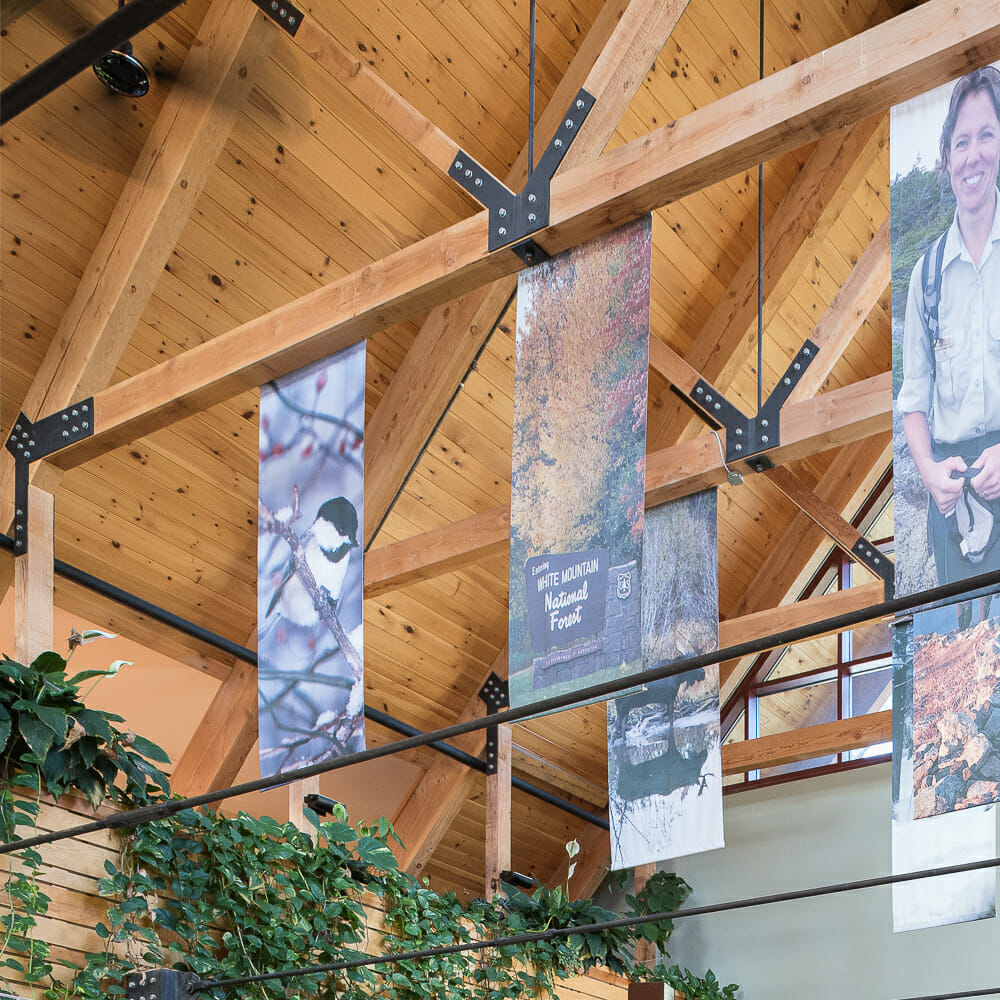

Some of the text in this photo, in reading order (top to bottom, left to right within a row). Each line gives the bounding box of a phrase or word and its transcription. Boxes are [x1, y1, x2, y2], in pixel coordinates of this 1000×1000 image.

[531, 561, 550, 576] Entering
[537, 558, 599, 592] WHITE MOUNTAIN
[544, 580, 589, 613] National
[549, 605, 583, 631] Forest
